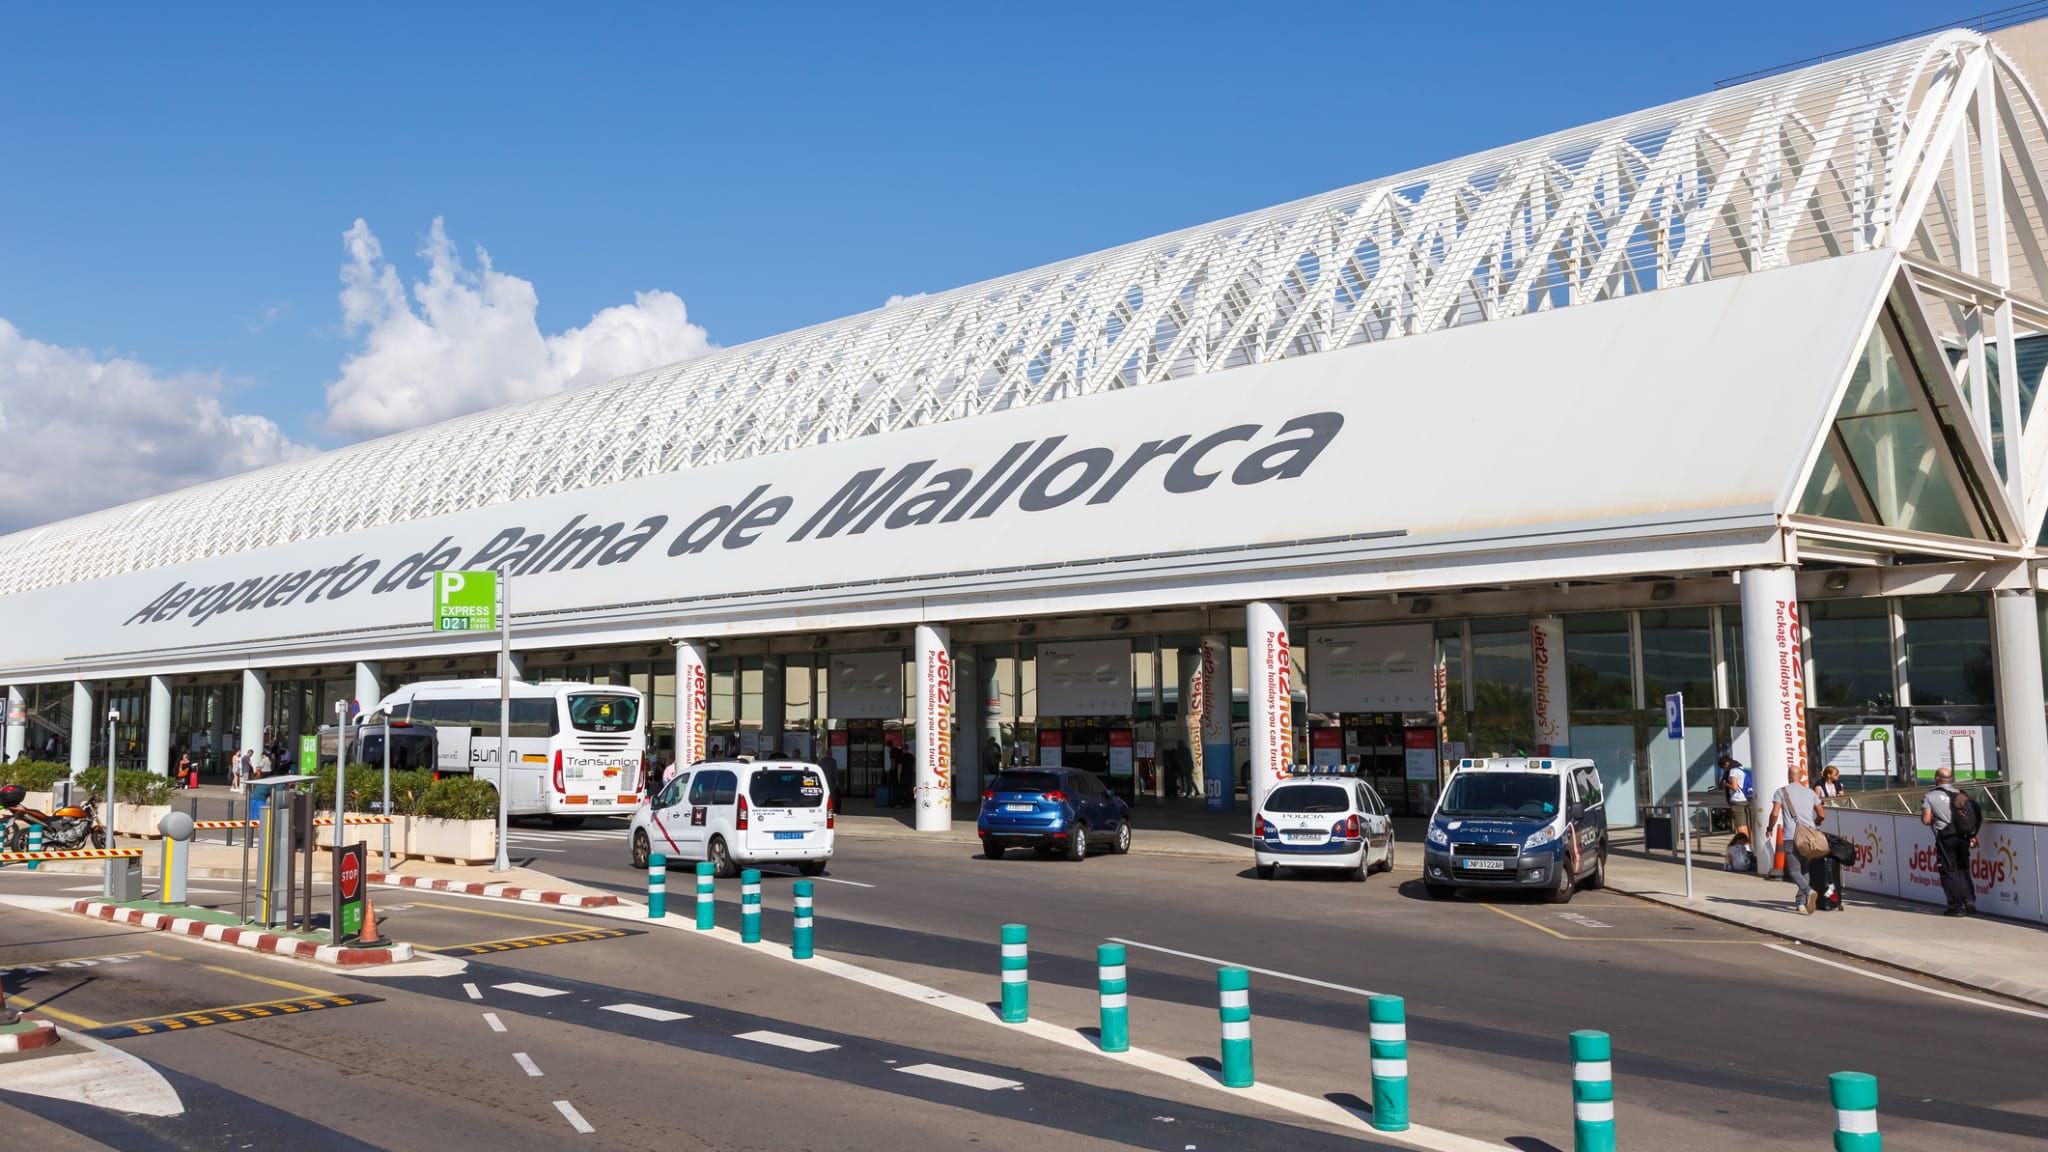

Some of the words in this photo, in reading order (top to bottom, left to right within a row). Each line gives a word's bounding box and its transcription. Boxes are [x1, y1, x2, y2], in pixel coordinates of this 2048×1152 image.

[122, 553, 381, 627] Aeropuerto
[371, 536, 462, 595] de
[459, 514, 669, 578] Palma
[667, 483, 794, 557] de
[786, 411, 1345, 543] Mallorca
[441, 572, 465, 604] P
[441, 606, 490, 616] EXPRESS
[442, 617, 467, 629] 021
[1776, 600, 1787, 649] Package
[1266, 631, 1275, 670] Package
[928, 650, 936, 683] Package
[1779, 650, 1791, 701] holidays
[928, 683, 936, 716] holidays
[1267, 671, 1277, 710] holidays
[1268, 711, 1276, 728] you
[1781, 701, 1791, 721] you
[1784, 723, 1793, 744] can
[566, 756, 639, 768] Transunion
[929, 744, 937, 767] trust
[1270, 748, 1278, 771] trust
[1787, 745, 1796, 769] trus
[341, 868, 358, 881] STOP
[1910, 873, 1931, 887] Package
[1975, 883, 1989, 895] trust
